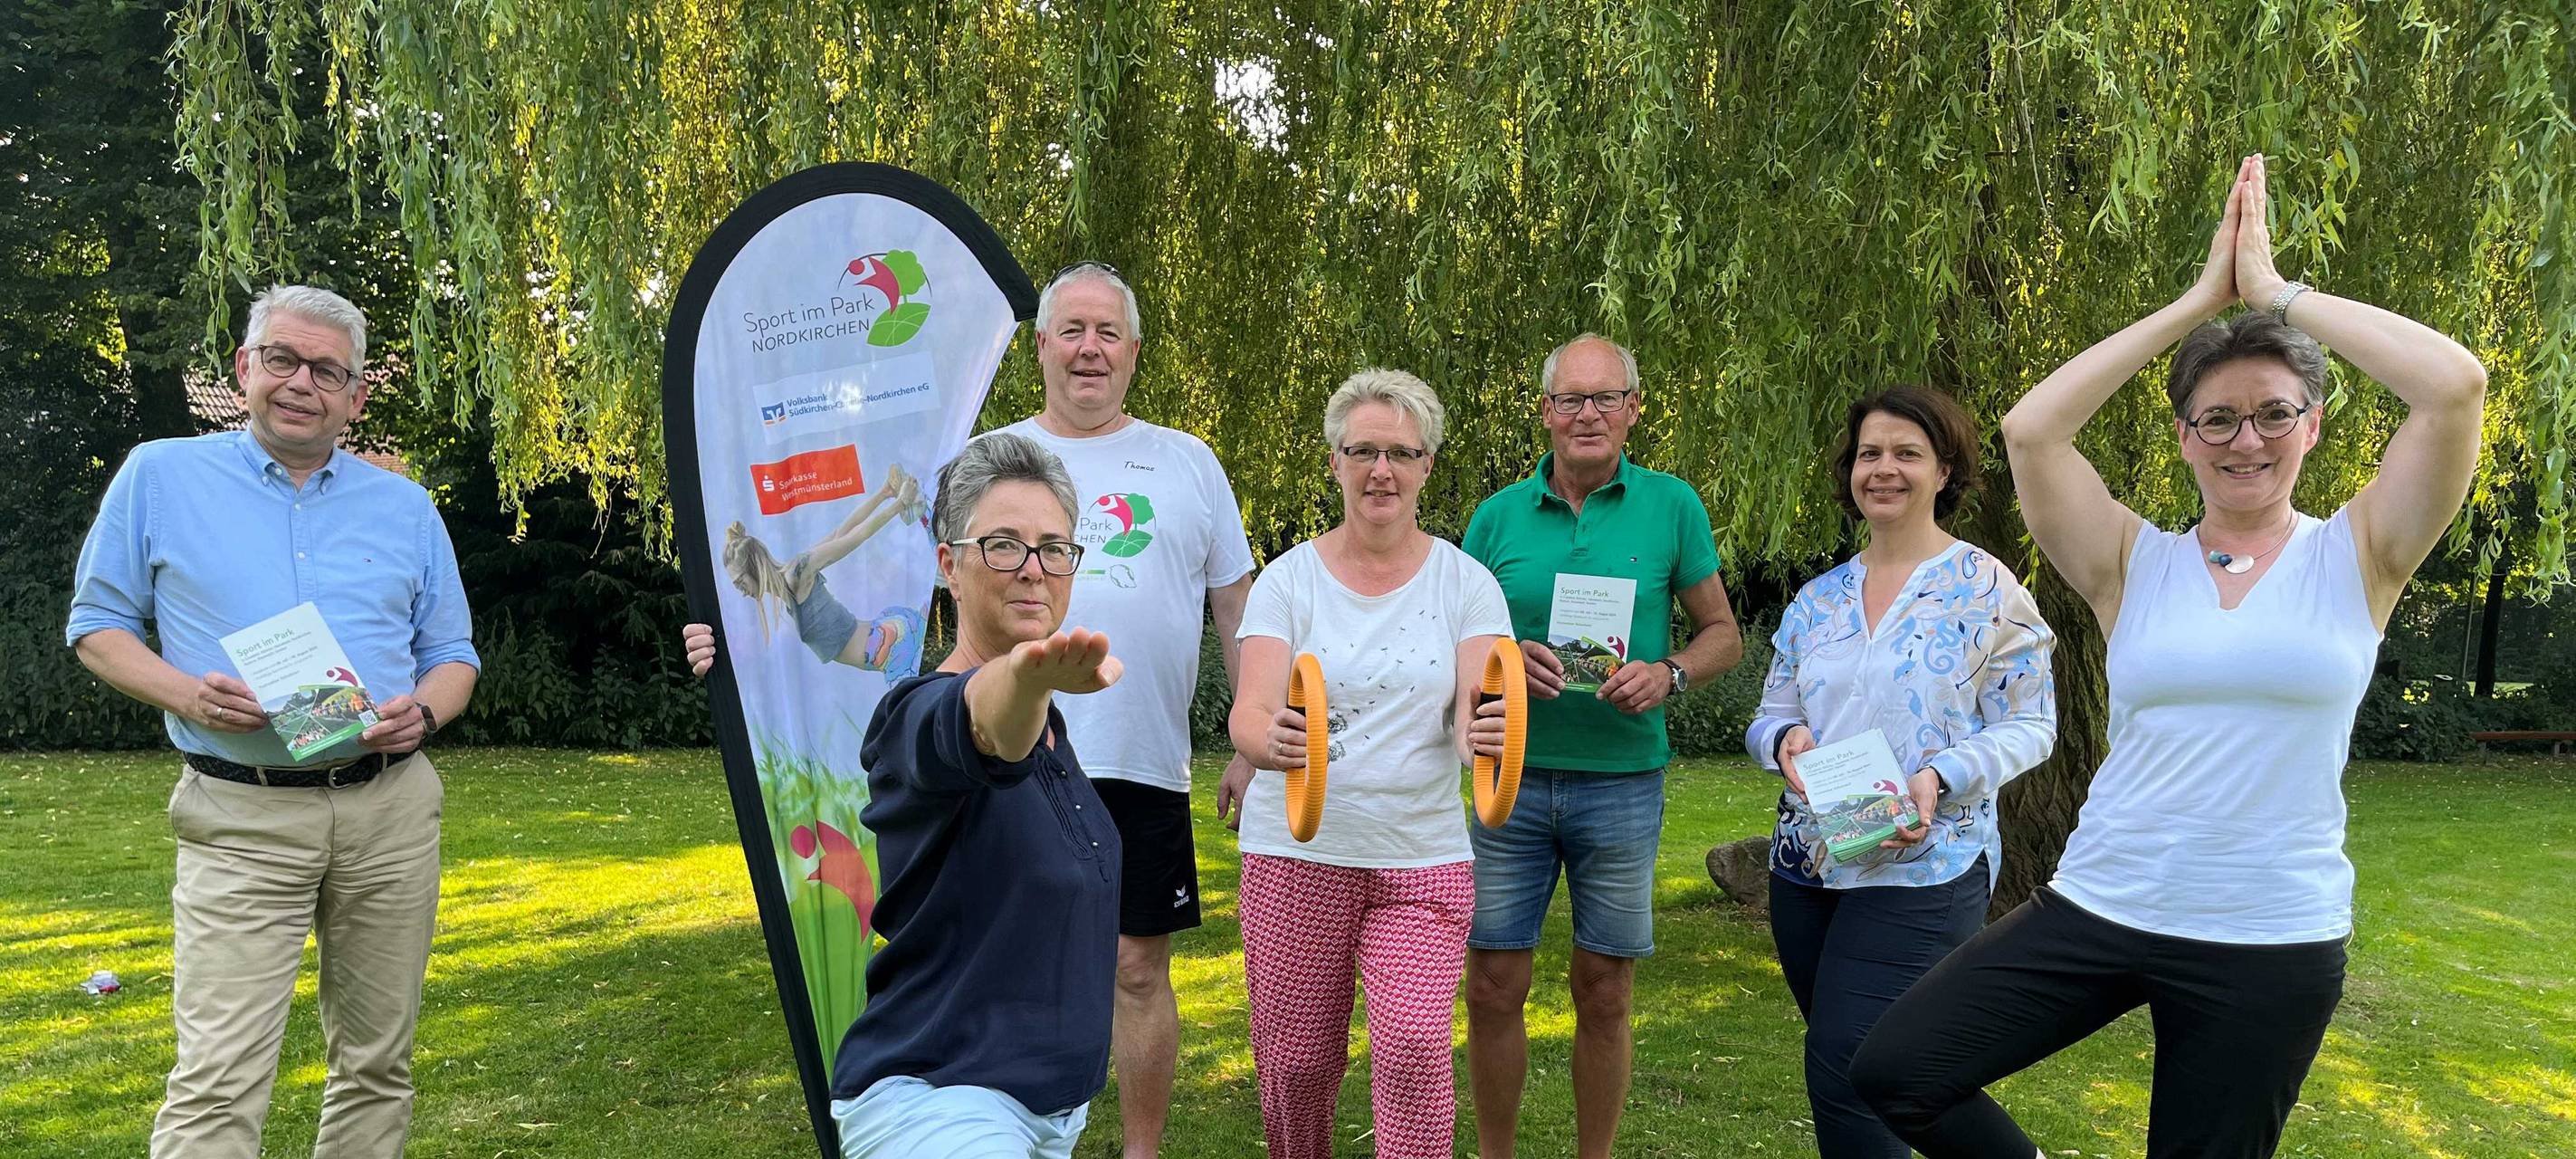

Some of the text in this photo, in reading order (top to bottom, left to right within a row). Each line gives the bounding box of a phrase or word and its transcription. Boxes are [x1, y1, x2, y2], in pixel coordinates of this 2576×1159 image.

[743, 292, 875, 338] Sport im Park
[752, 319, 870, 353] NORDKIRCHEN
[917, 382, 930, 392] eG
[787, 393, 828, 407] Volksbank
[778, 472, 817, 490] Sparkasse
[1080, 517, 1113, 531] Park
[1560, 587, 1580, 595] Sport
[1593, 589, 1608, 598] Park
[236, 643, 262, 657] Sport
[262, 637, 274, 646] im
[274, 628, 295, 641] Park
